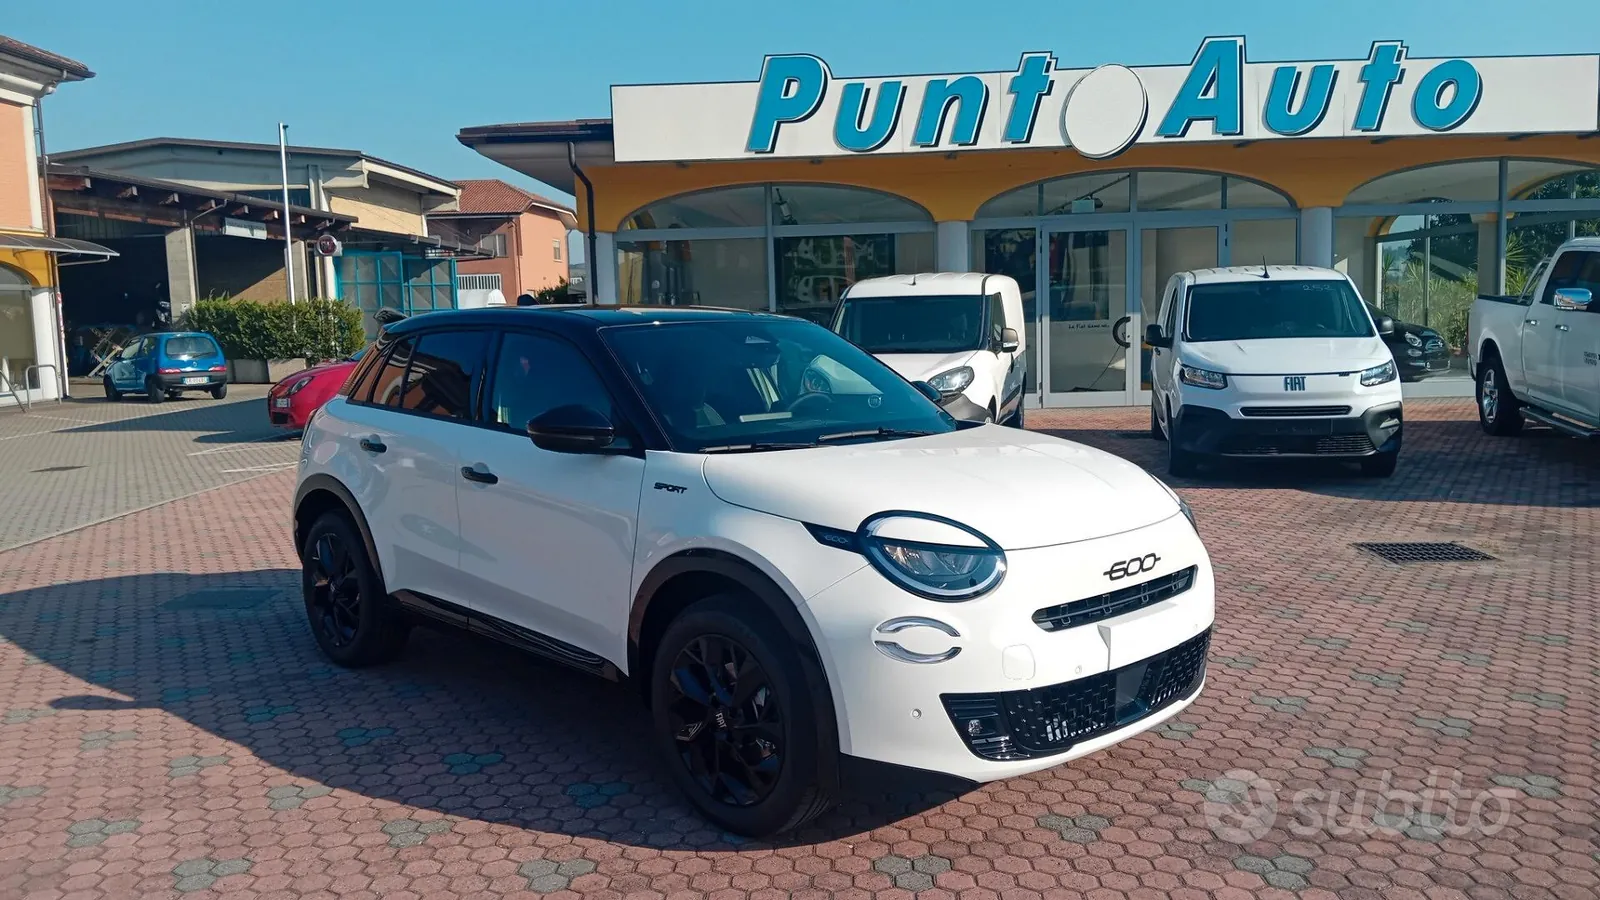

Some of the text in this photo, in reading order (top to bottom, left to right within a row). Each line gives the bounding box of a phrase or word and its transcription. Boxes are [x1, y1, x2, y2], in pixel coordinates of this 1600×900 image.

[1155, 38, 1483, 137] Auto
[1284, 376, 1306, 392] FIAT
[653, 482, 688, 494] SPORT
[1103, 552, 1161, 581] 600
[715, 712, 727, 729] FIAT
